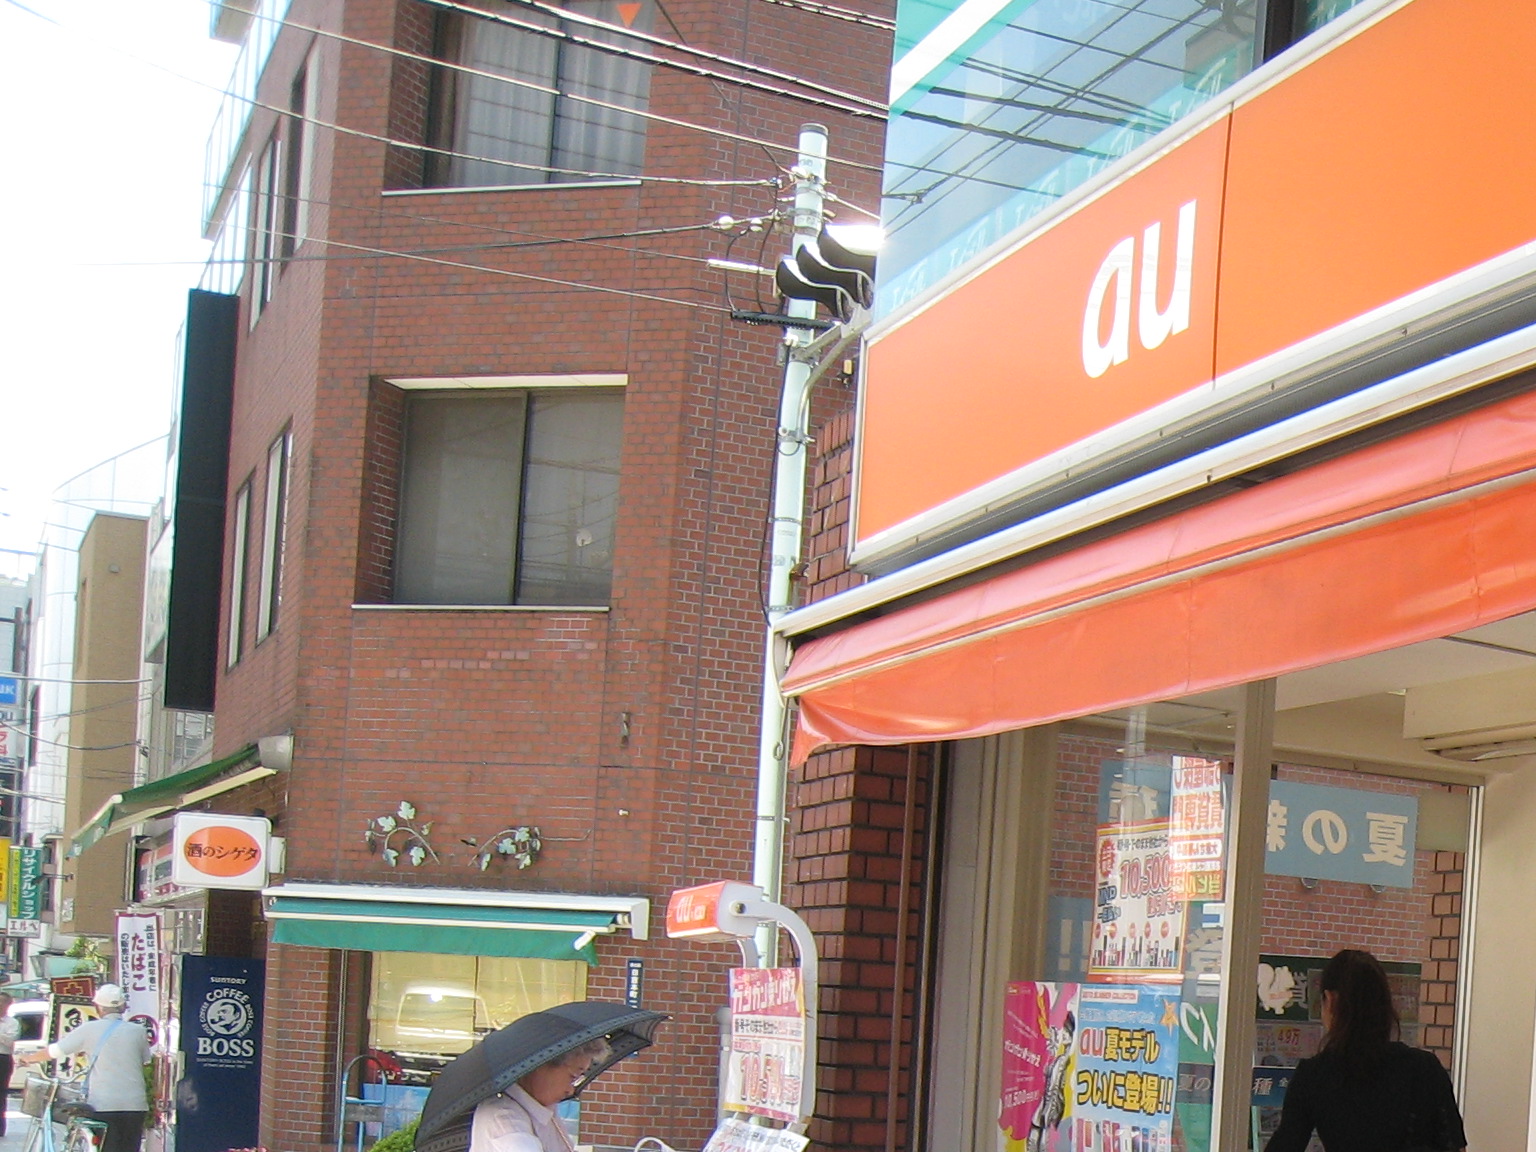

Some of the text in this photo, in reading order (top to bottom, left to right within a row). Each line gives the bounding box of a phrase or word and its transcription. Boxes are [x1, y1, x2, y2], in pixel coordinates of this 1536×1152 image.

[1082, 199, 1197, 379] au
[187, 842, 259, 861] 酒のシゲタ
[131, 932, 147, 992] たばこ
[205, 987, 250, 1004] COFFEE
[197, 1037, 254, 1057] BOSS
[1080, 1027, 1161, 1064] au夏モデル
[1077, 1069, 1174, 1116] ついに登場!!
